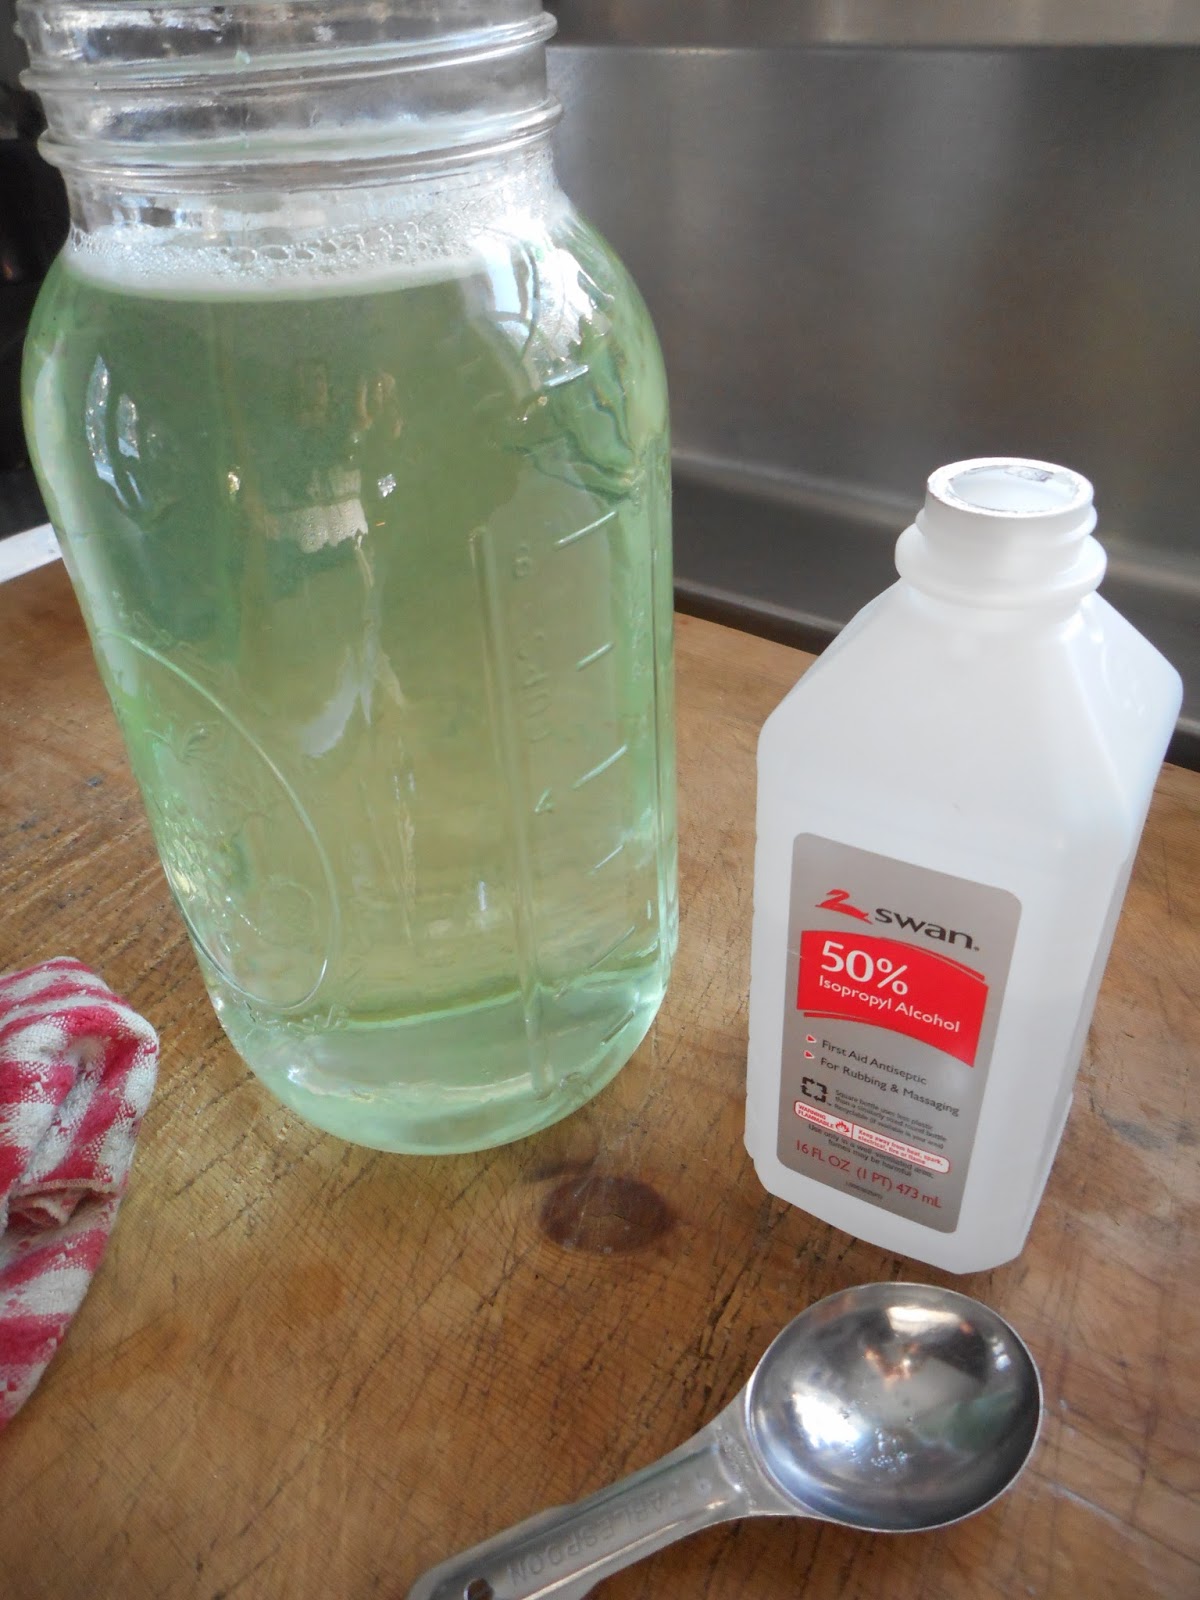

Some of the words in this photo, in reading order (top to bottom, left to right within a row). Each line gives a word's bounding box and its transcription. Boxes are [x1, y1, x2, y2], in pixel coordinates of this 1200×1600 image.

[820, 940, 909, 995] 50%
[819, 975, 892, 1010] Isopropyl
[895, 1001, 960, 1033] Alcohol
[822, 1039, 847, 1055] First
[848, 1050, 868, 1065] Aid
[869, 1058, 927, 1085] Antiseptic
[820, 1057, 840, 1072] For
[842, 1066, 887, 1092] Rubbing
[890, 1083, 899, 1094] &
[903, 1088, 960, 1118] Massaging
[797, 1109, 834, 1129] FLAMMABLE
[798, 1103, 827, 1120] WARNING
[808, 1123, 823, 1135] Use
[858, 1129, 874, 1140] Keep
[875, 1136, 890, 1146] away
[891, 1142, 905, 1152] from
[796, 1139, 810, 1155] 16
[811, 1146, 826, 1162] FL
[828, 1155, 851, 1172] OZ
[856, 1167, 868, 1180] (1
[871, 1171, 893, 1191] PT)
[896, 1183, 920, 1199] 473
[921, 1193, 942, 1209] mL
